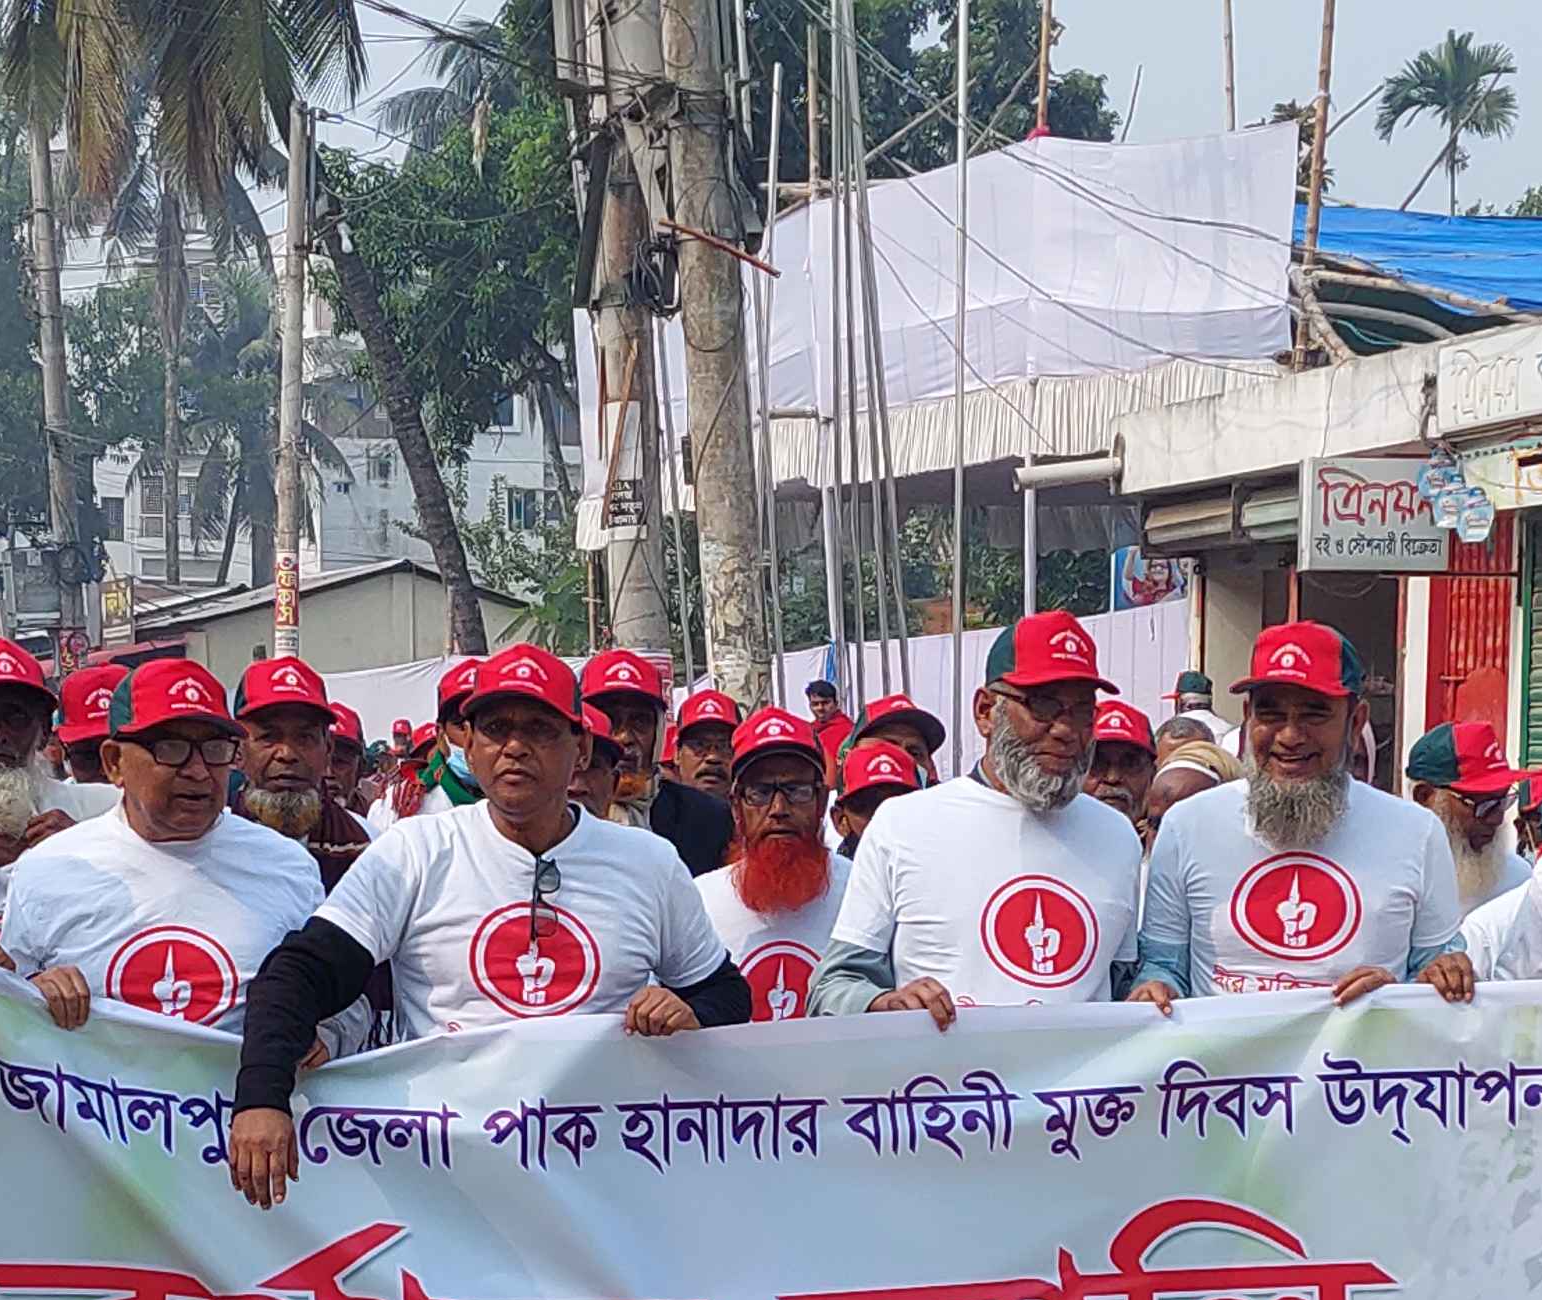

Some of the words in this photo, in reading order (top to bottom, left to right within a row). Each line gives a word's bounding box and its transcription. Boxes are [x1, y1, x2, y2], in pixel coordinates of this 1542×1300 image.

[1314, 533, 1332, 557] বই
[298, 1102, 460, 1170] জেলা
[484, 1097, 603, 1171] পাক
[619, 1094, 828, 1173] হানাদার
[843, 1069, 1019, 1160] বাহিনী
[1035, 1086, 1142, 1157] মুক্ত
[1159, 1060, 1303, 1139] দিবস
